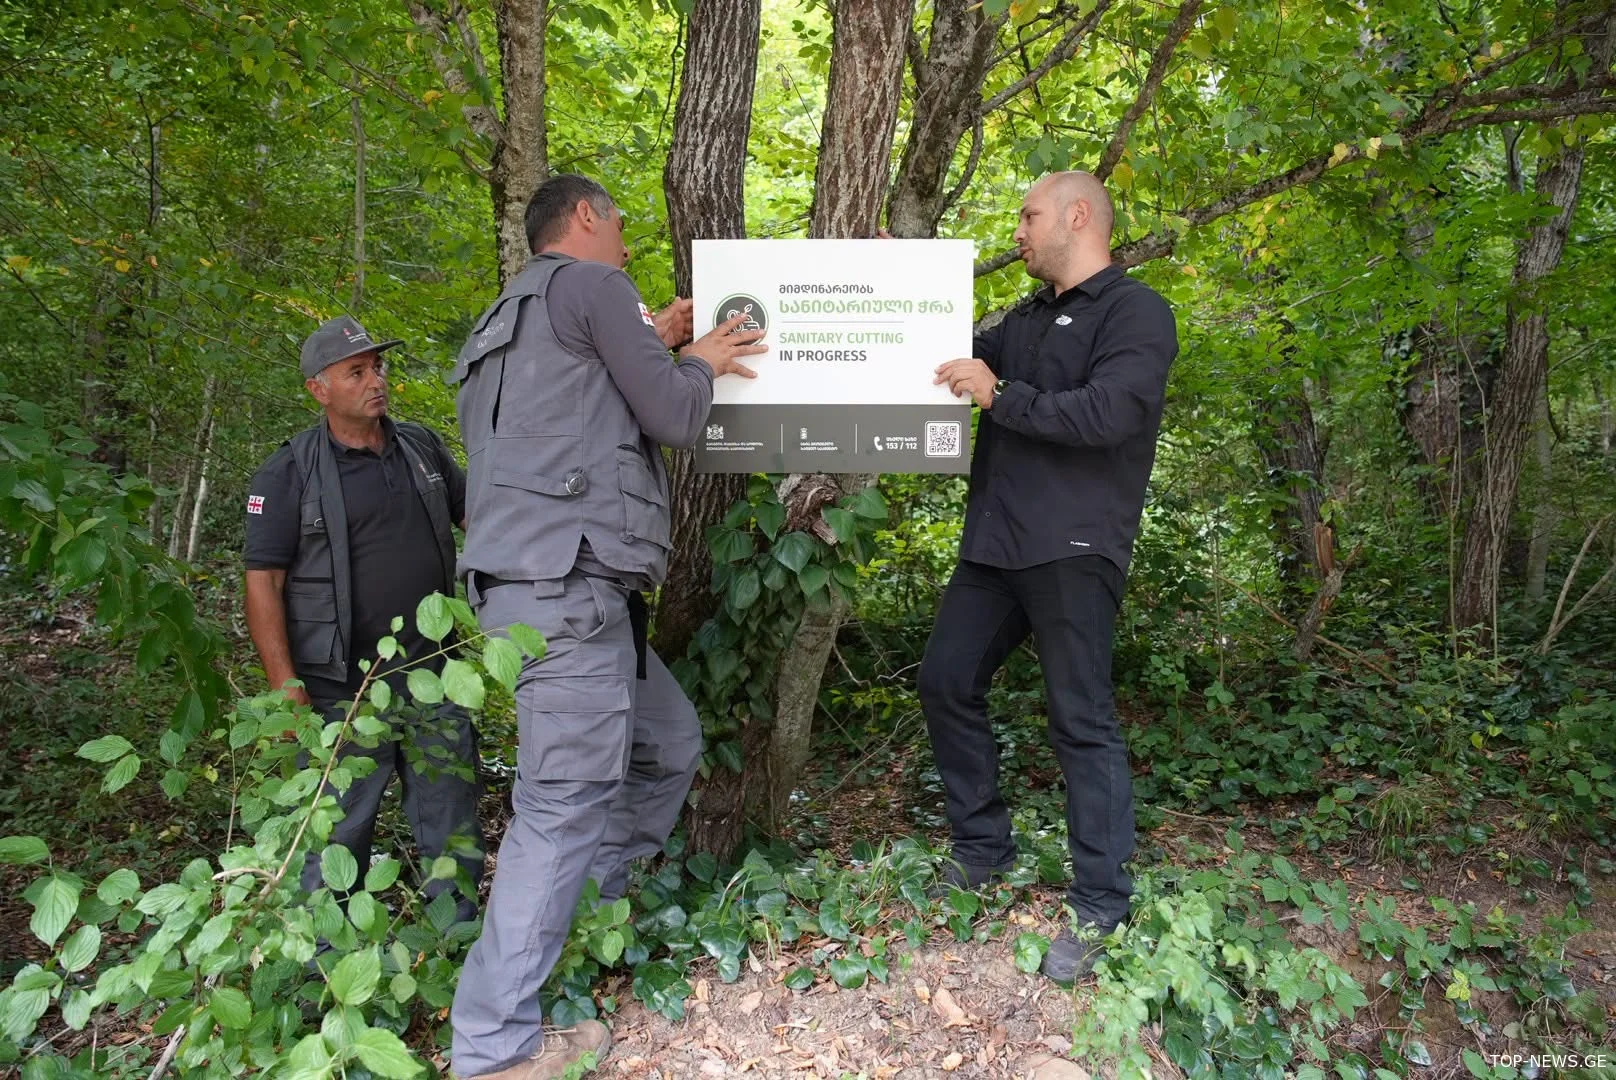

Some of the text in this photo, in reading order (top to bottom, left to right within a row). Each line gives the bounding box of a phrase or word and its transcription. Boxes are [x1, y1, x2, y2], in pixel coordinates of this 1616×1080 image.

[779, 284, 874, 294] მიმდინარეობს
[779, 299, 954, 314] სანიტარიული ჭრა
[779, 332, 904, 344] SANITARY CUTTING
[779, 350, 867, 361] IN PROGRESS
[886, 442, 899, 450] 153
[905, 442, 918, 450] 112
